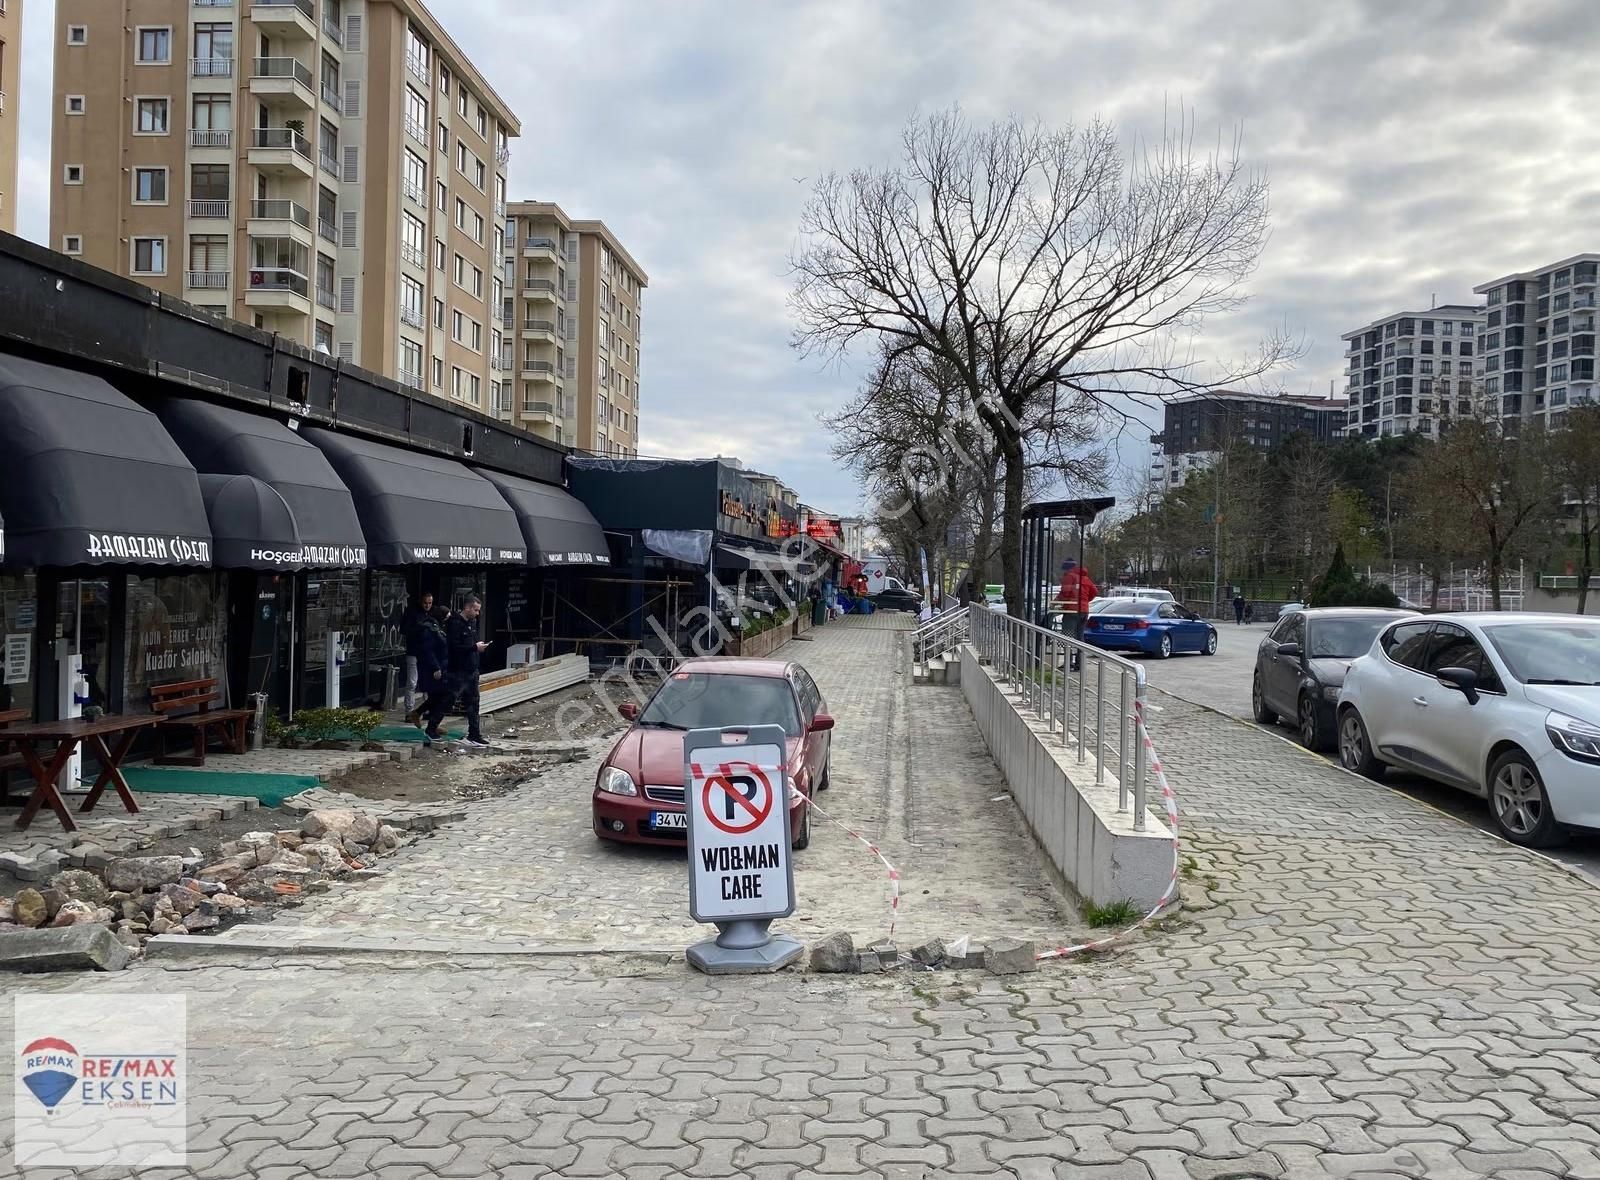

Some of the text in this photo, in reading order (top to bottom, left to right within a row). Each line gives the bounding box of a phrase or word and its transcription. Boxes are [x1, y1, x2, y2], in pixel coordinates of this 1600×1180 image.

[86, 533, 210, 562] RAMAZAN ÇİDEM
[341, 545, 366, 566] ÇİDEM
[449, 546, 476, 560] RAMAZAN
[145, 649, 178, 671] Kuaför
[657, 814, 671, 826] 34
[701, 843, 780, 872] WO&MAN
[720, 874, 763, 901] CARE
